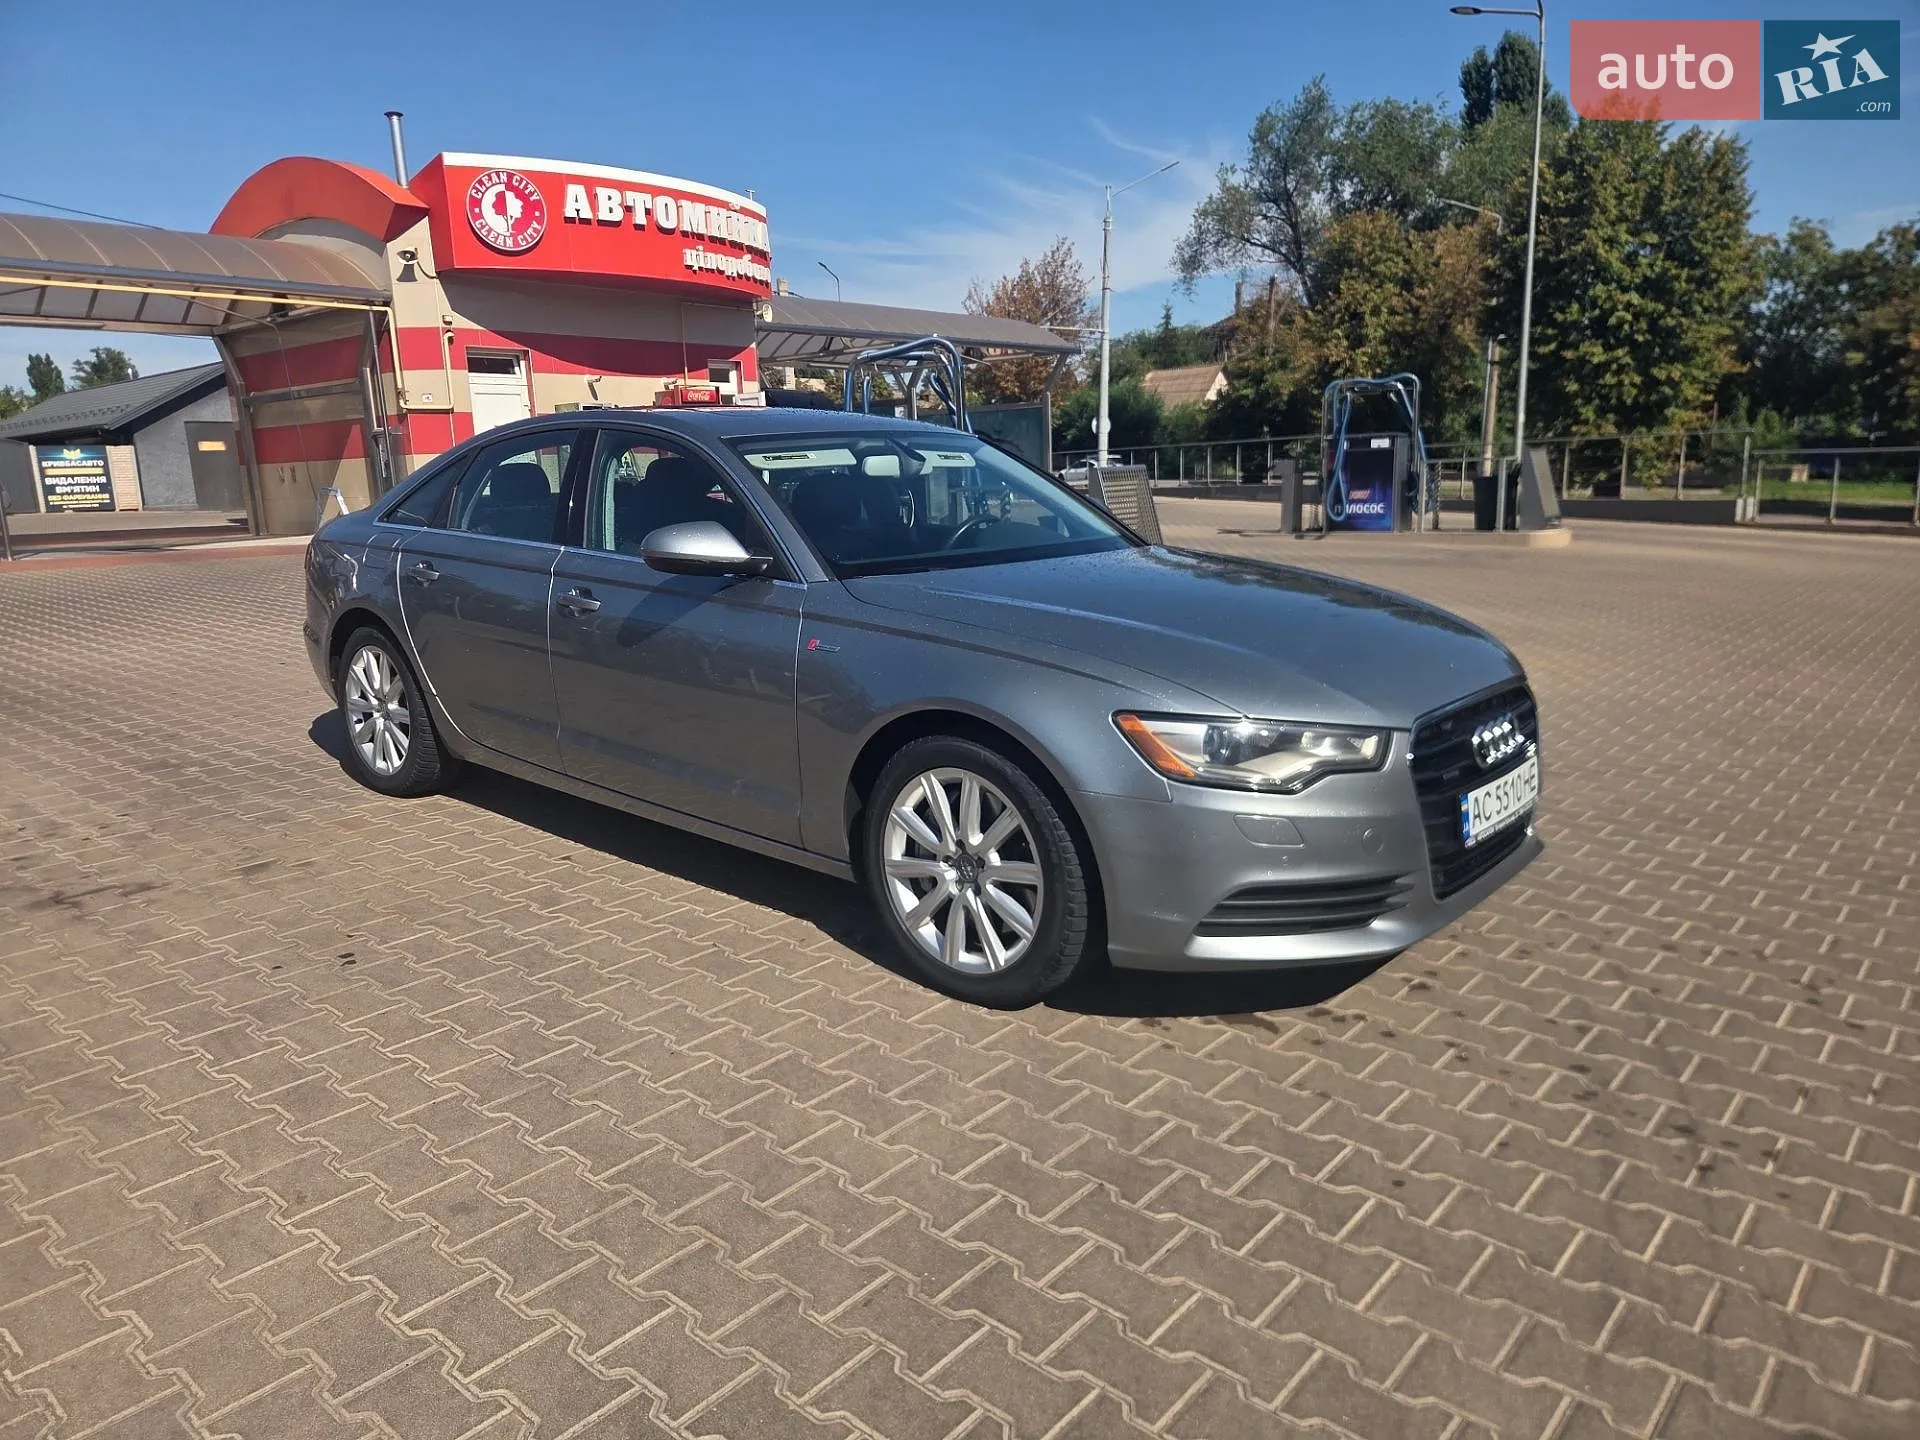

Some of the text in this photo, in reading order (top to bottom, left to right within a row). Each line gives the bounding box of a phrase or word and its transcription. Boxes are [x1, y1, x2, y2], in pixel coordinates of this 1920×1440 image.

[471, 171, 541, 202] CLEAN CITY
[475, 218, 542, 248] CLEAN CITY
[45, 476, 107, 485] ВИДАЛЕННЯ
[1472, 790, 1492, 829] AC
[1495, 773, 1522, 817] 5510
[1521, 760, 1537, 800] HE
